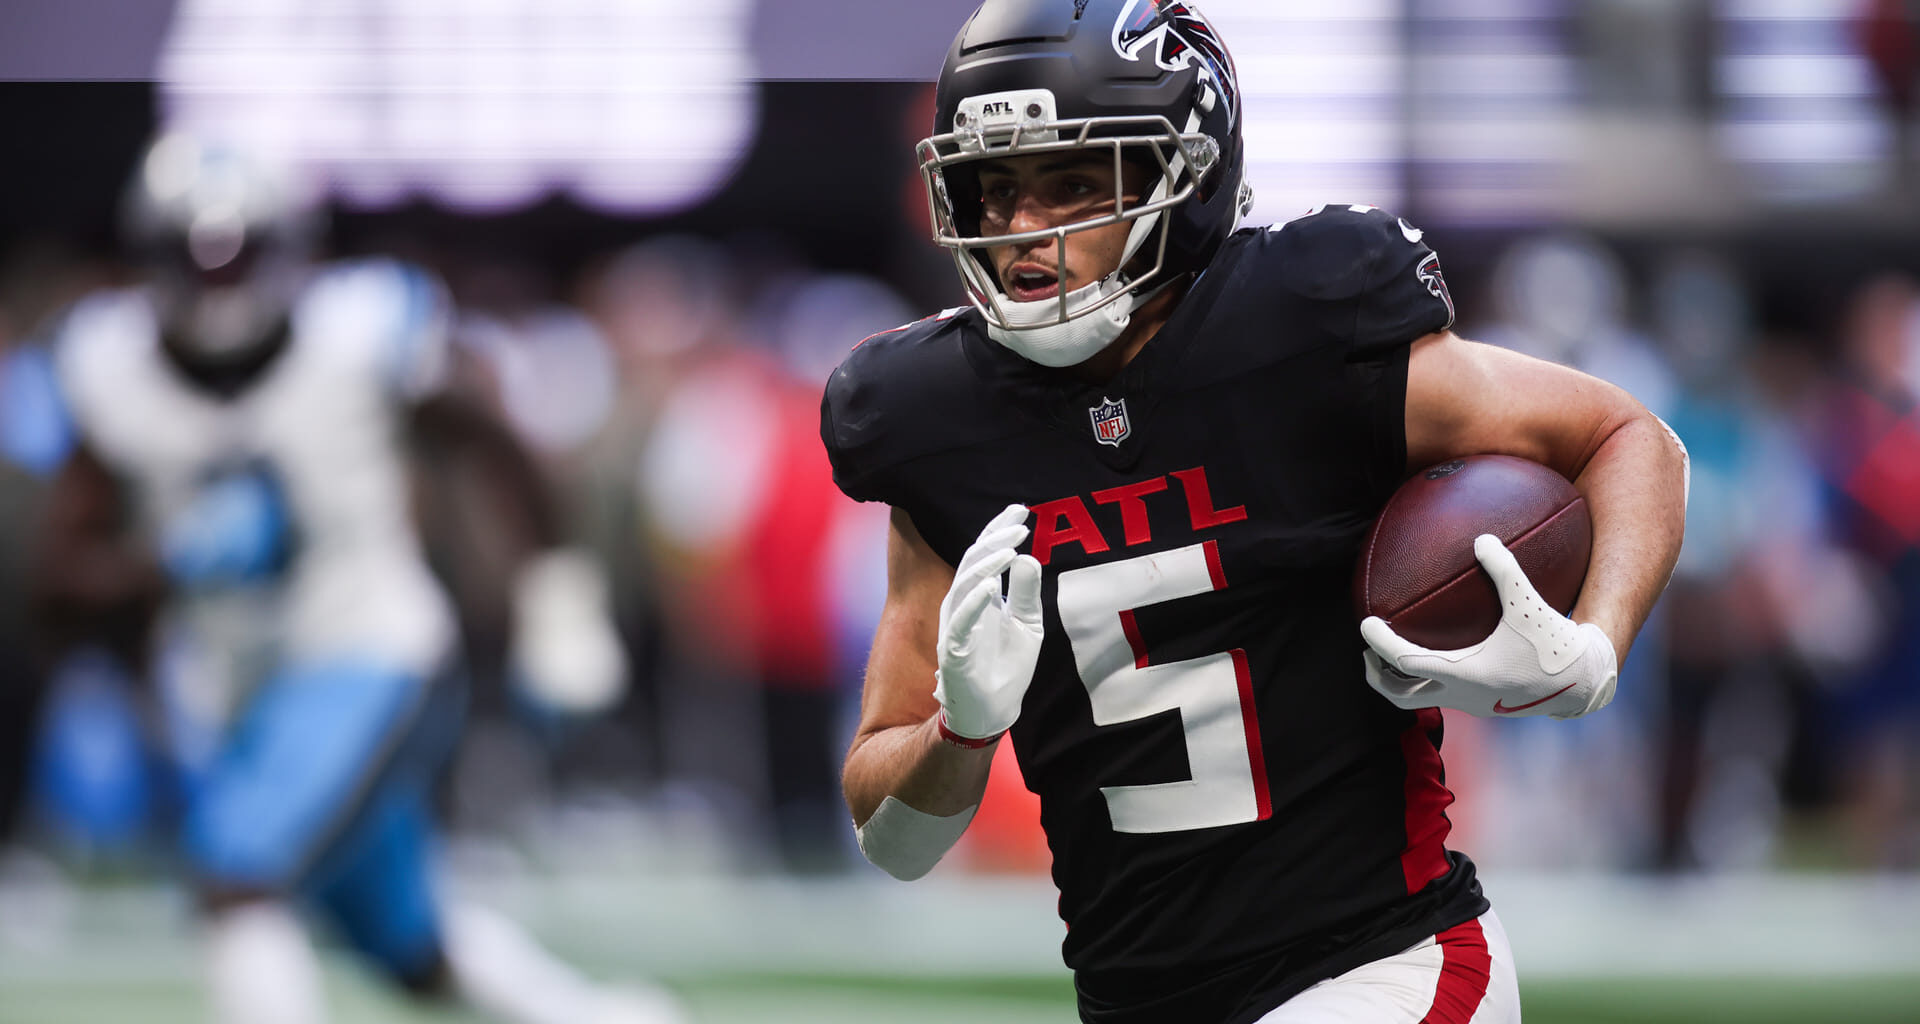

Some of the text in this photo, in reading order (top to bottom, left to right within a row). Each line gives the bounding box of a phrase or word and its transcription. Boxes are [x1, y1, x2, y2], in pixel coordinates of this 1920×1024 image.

[983, 101, 1013, 114] ATL
[1098, 418, 1125, 438] NFL
[1028, 466, 1248, 565] ATL
[1057, 539, 1272, 834] 5
